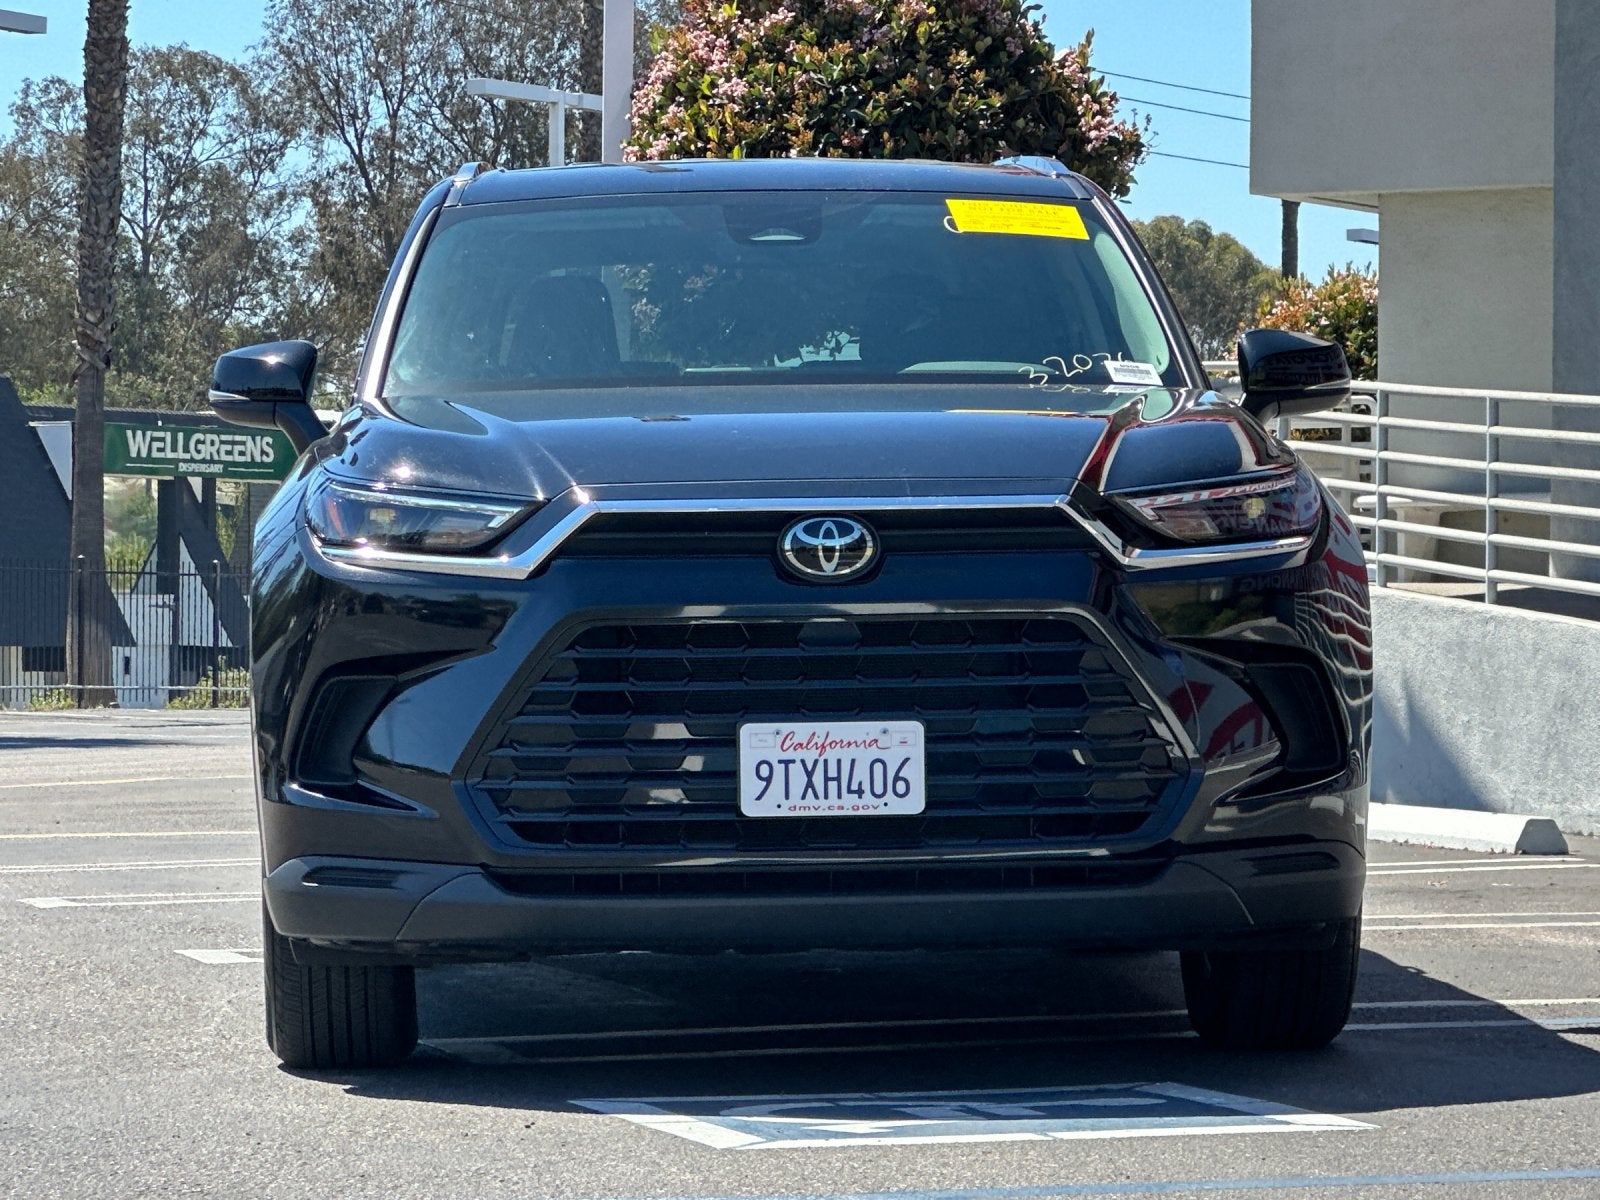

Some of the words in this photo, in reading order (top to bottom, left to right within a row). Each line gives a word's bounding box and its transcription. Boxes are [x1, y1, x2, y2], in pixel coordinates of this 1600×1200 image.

[125, 429, 275, 463] WELLGREENS
[177, 462, 224, 473] DISPENSARY
[780, 730, 891, 758] California
[754, 756, 911, 801] 9TXH406
[787, 803, 880, 812] dmv.ca.gov
